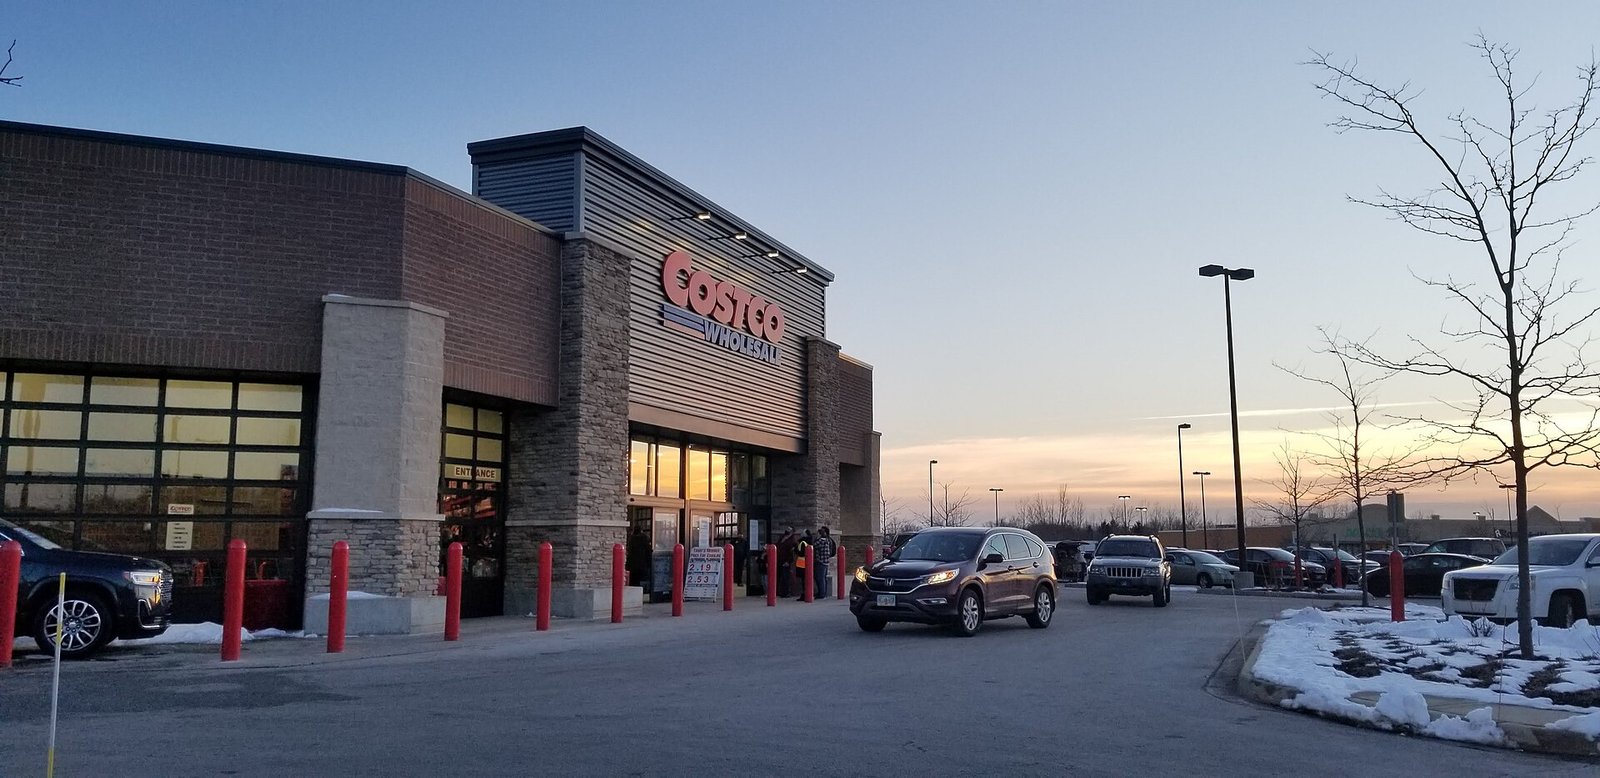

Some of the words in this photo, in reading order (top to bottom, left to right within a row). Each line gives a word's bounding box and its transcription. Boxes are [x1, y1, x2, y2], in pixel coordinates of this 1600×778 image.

[663, 250, 785, 343] COSTCO
[703, 319, 782, 366] WHOLESALE
[455, 467, 495, 478] ENTANCE
[689, 563, 711, 571] 2.19
